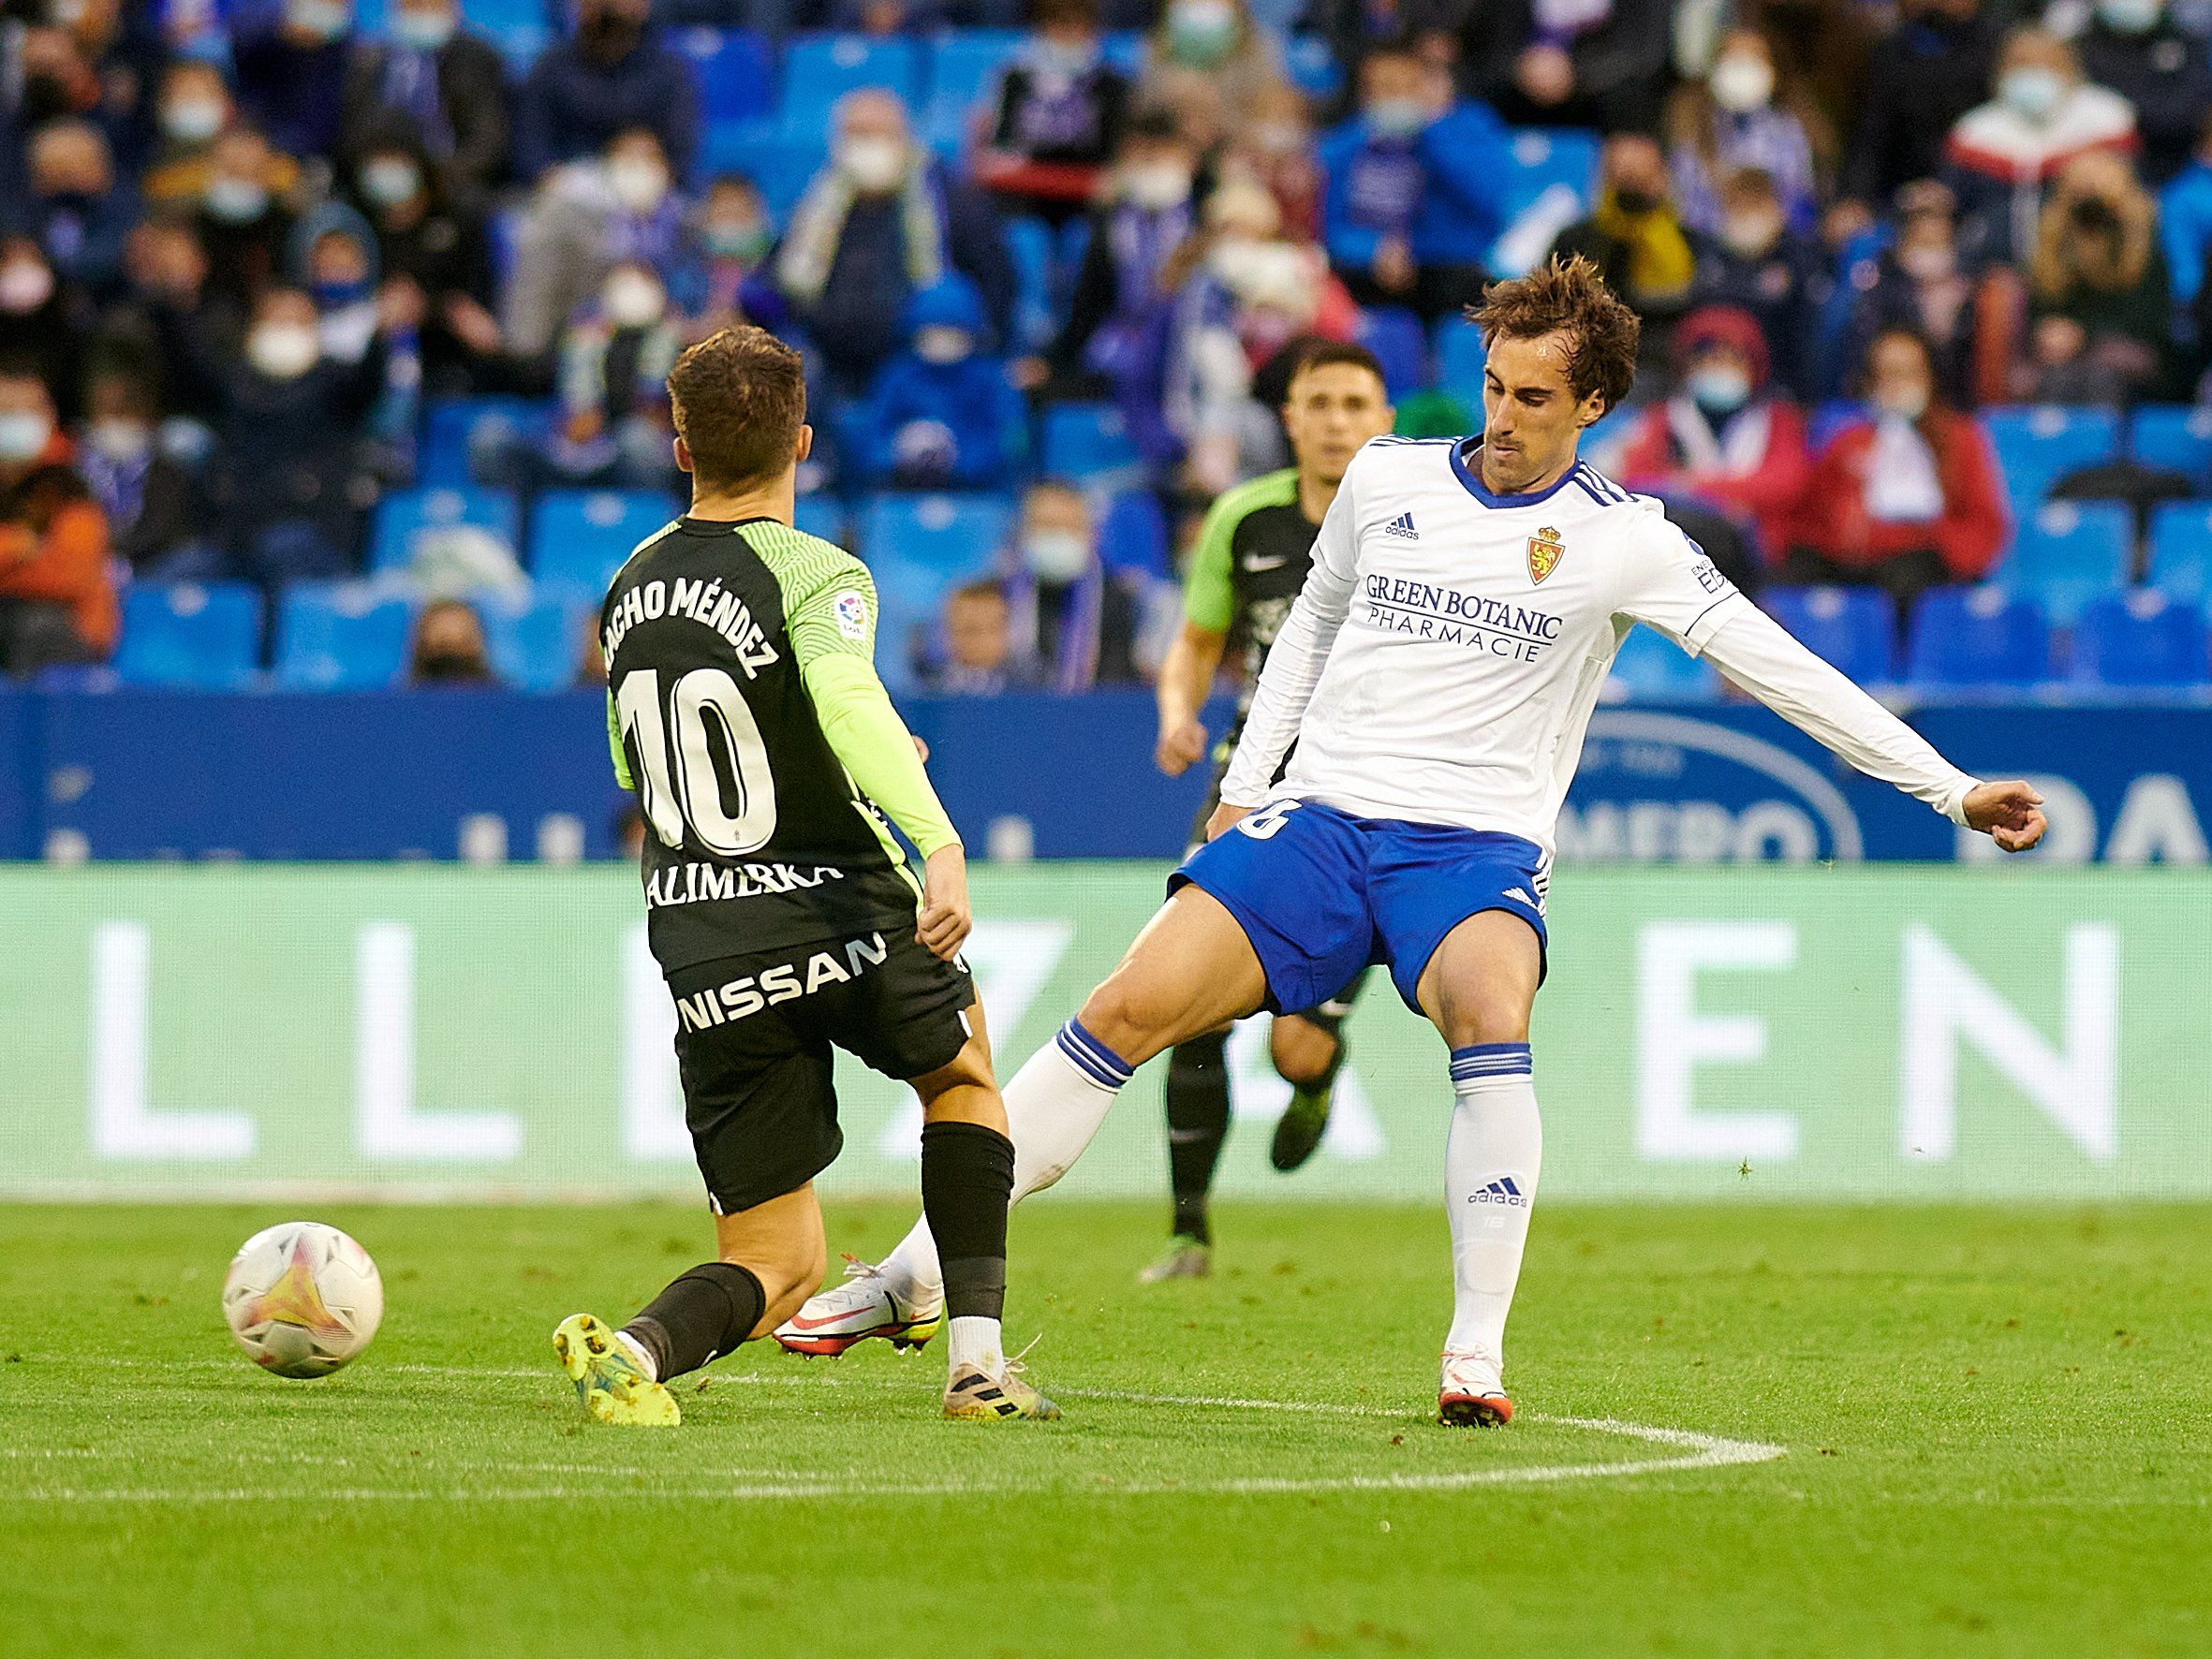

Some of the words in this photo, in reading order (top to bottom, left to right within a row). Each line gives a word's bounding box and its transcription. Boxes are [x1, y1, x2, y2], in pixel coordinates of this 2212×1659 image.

[1386, 526, 1419, 540] adidas
[668, 577, 779, 681] MÉNDEZ
[1366, 574, 1444, 611] GREEN
[1445, 591, 1563, 639] BOTANIC
[1367, 607, 1540, 663] PHARMACIE
[615, 668, 777, 857] 10
[677, 932, 887, 1034] NISSAN
[1634, 921, 2122, 1161] EN
[1468, 1192, 1526, 1207] adidas
